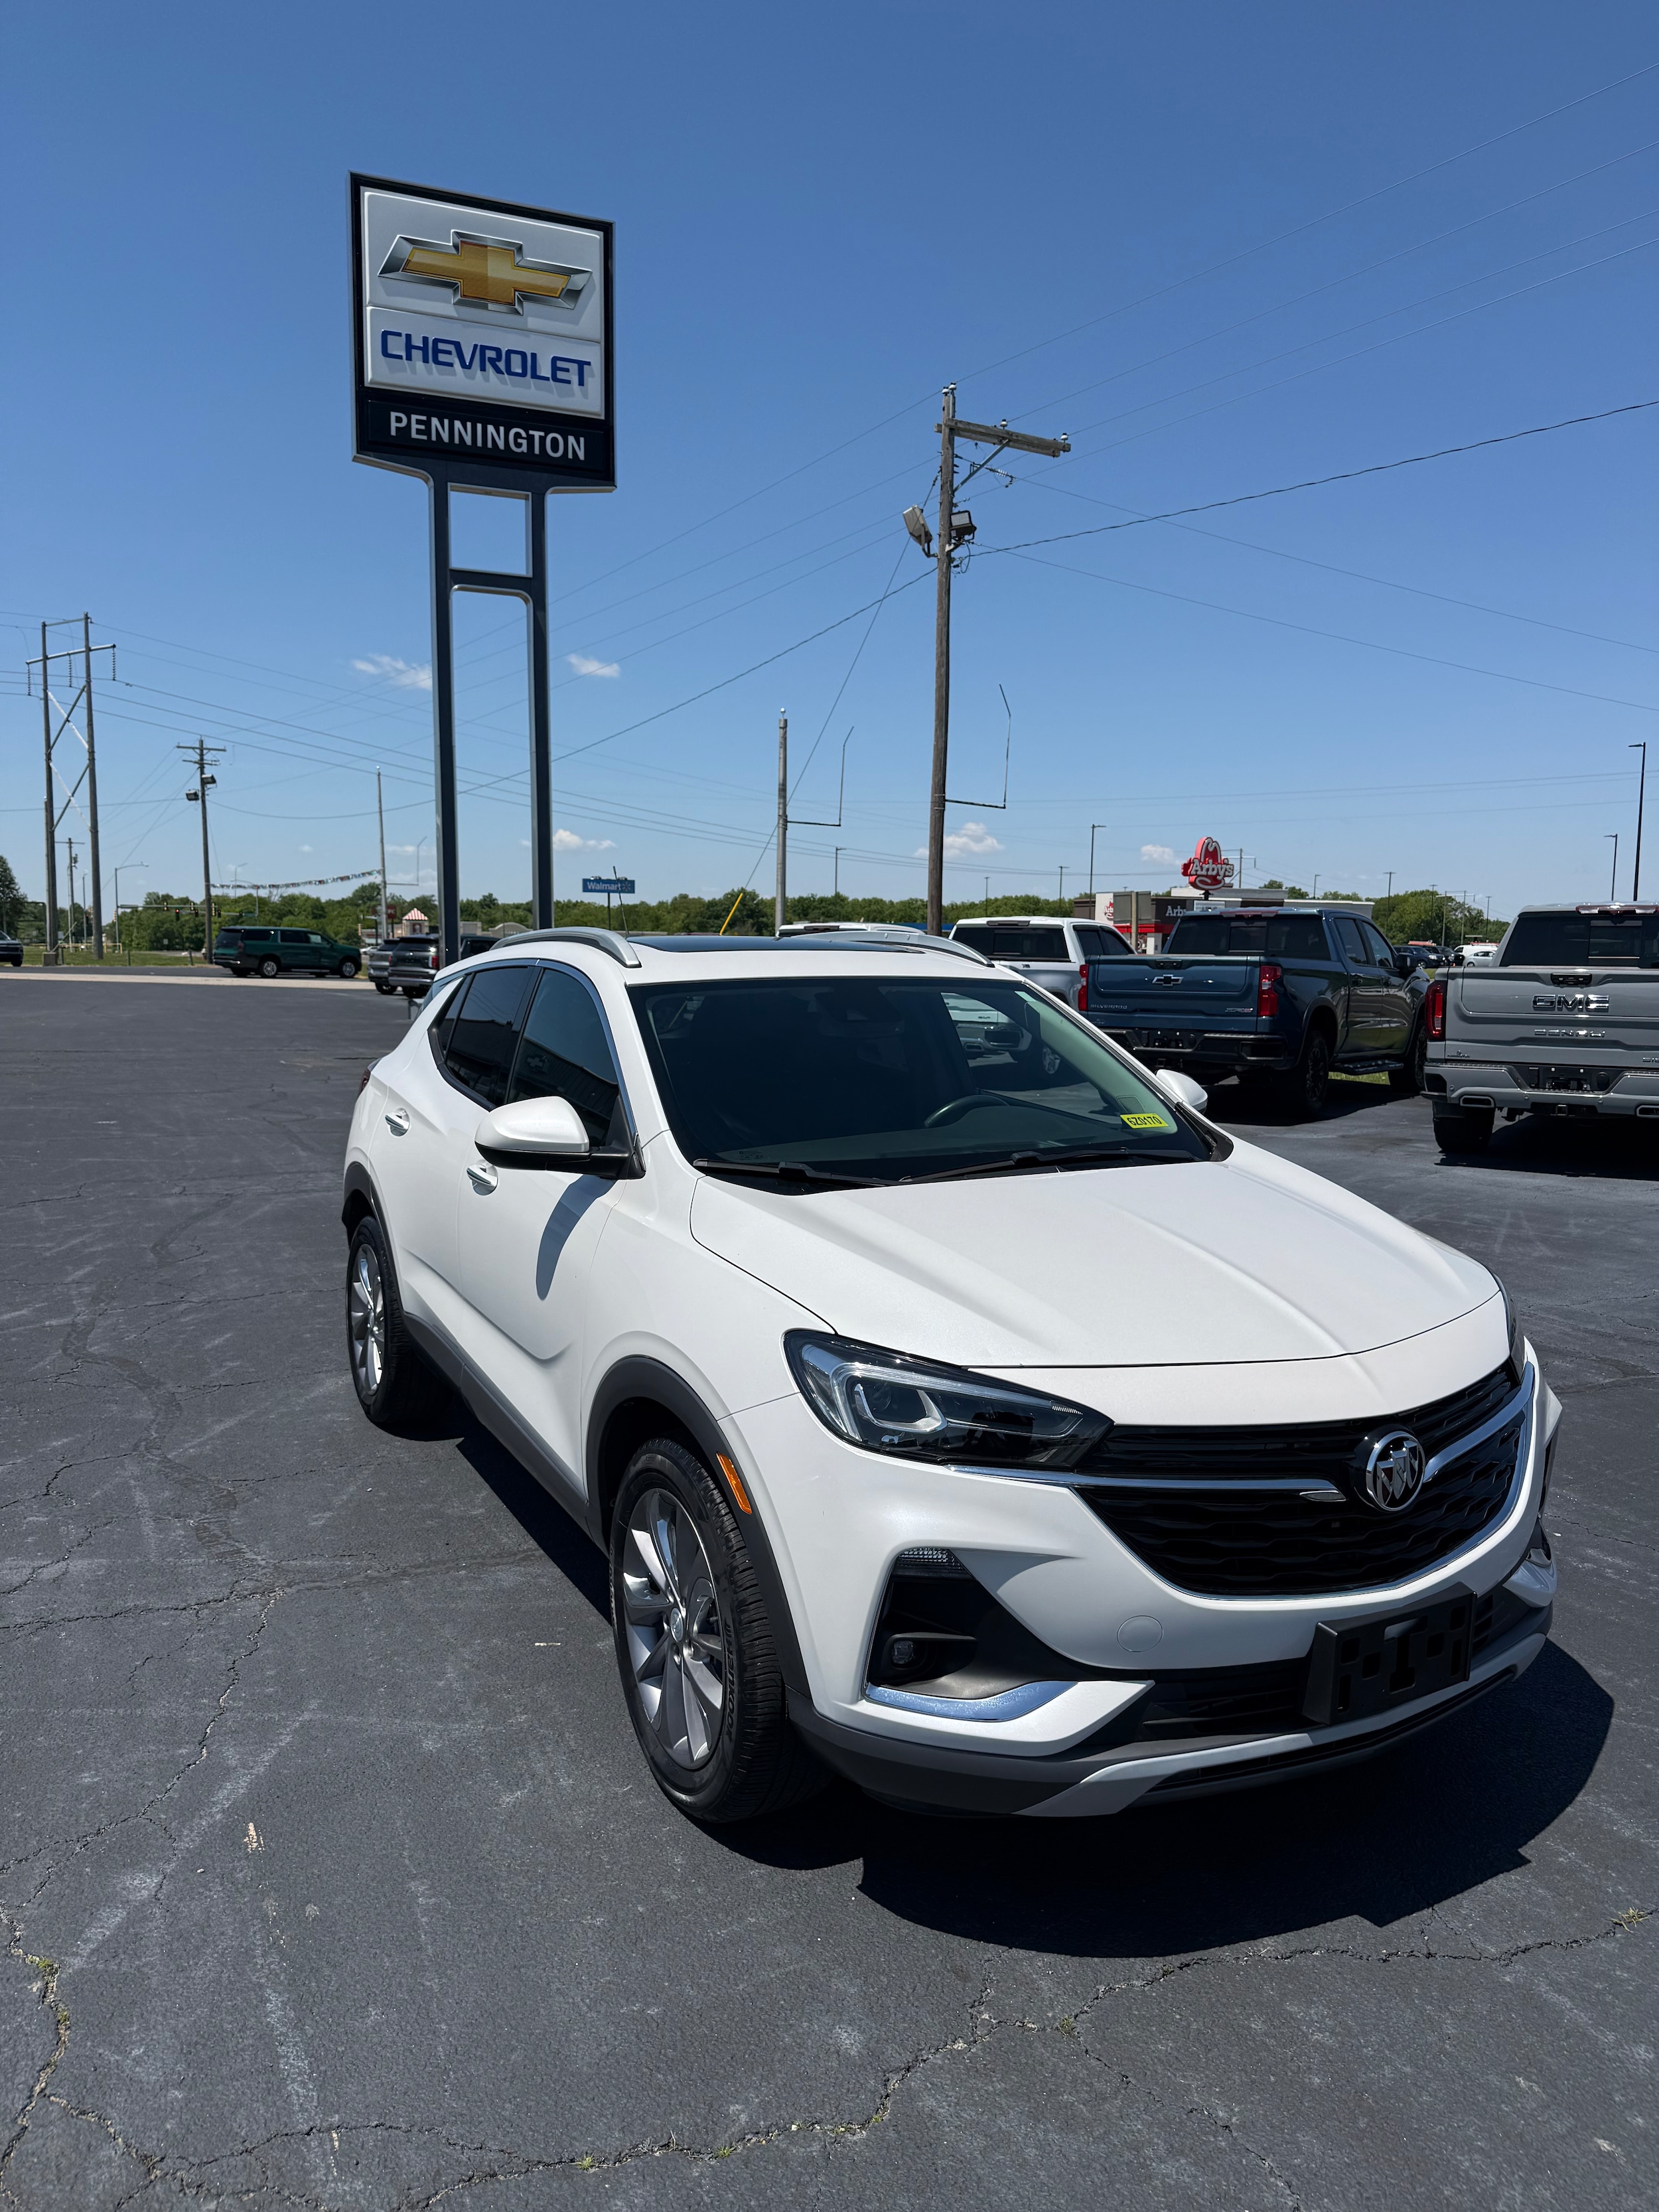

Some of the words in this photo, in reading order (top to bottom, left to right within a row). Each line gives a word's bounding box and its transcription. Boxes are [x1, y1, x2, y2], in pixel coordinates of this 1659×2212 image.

[381, 329, 591, 386] CHEVROLET
[390, 411, 585, 461] PENNINGTON
[1190, 858, 1234, 881] Arby's
[587, 881, 622, 891] Walmart
[1165, 905, 1186, 917] Arb
[1533, 994, 1609, 1009] GMC
